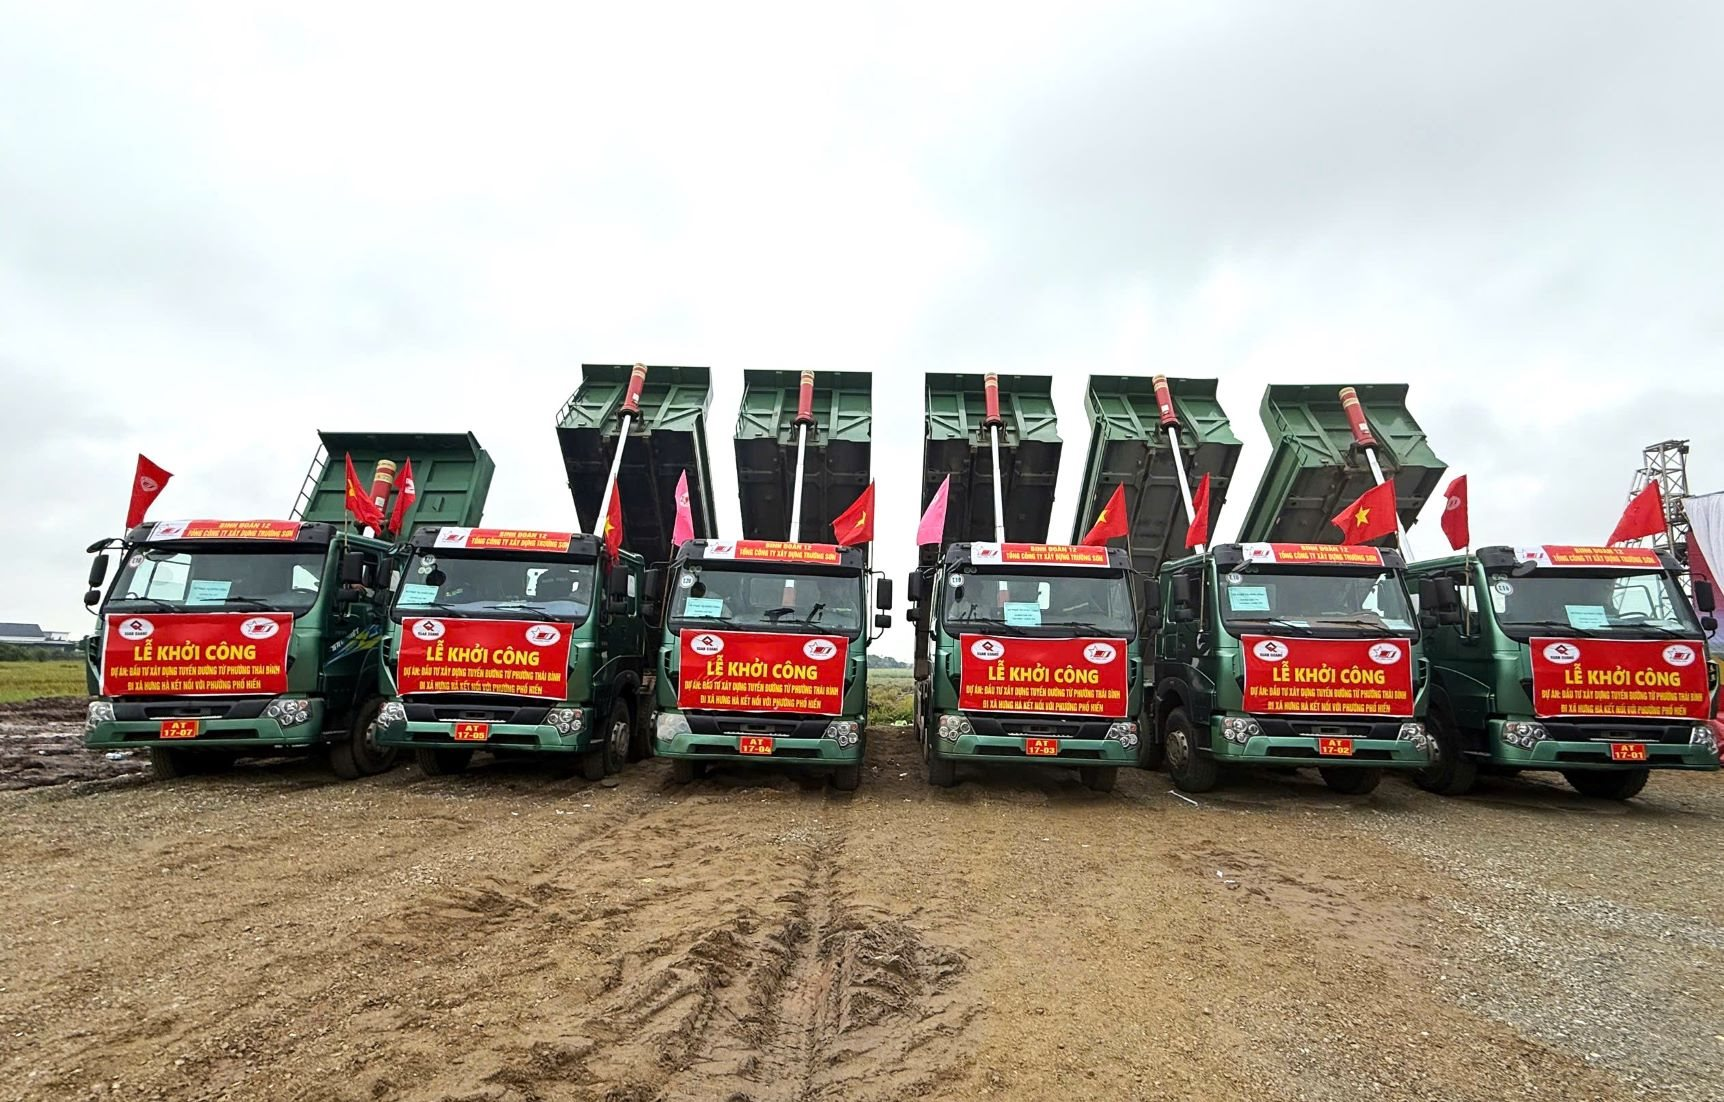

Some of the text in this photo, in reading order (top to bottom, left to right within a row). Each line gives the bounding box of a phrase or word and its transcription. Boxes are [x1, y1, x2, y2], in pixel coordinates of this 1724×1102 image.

[134, 639, 256, 661] LỄ KHỞI CÔNG
[426, 640, 539, 665] LỄ KHỞI CÔNG
[707, 655, 817, 680] LỄ KHỞI CÔNG
[988, 660, 1099, 684] LỄ KHỞI CÔNG
[1273, 661, 1385, 684] LỄ KHỞI CÔNG
[1565, 663, 1680, 686] LỄ KHỞI CÔNG
